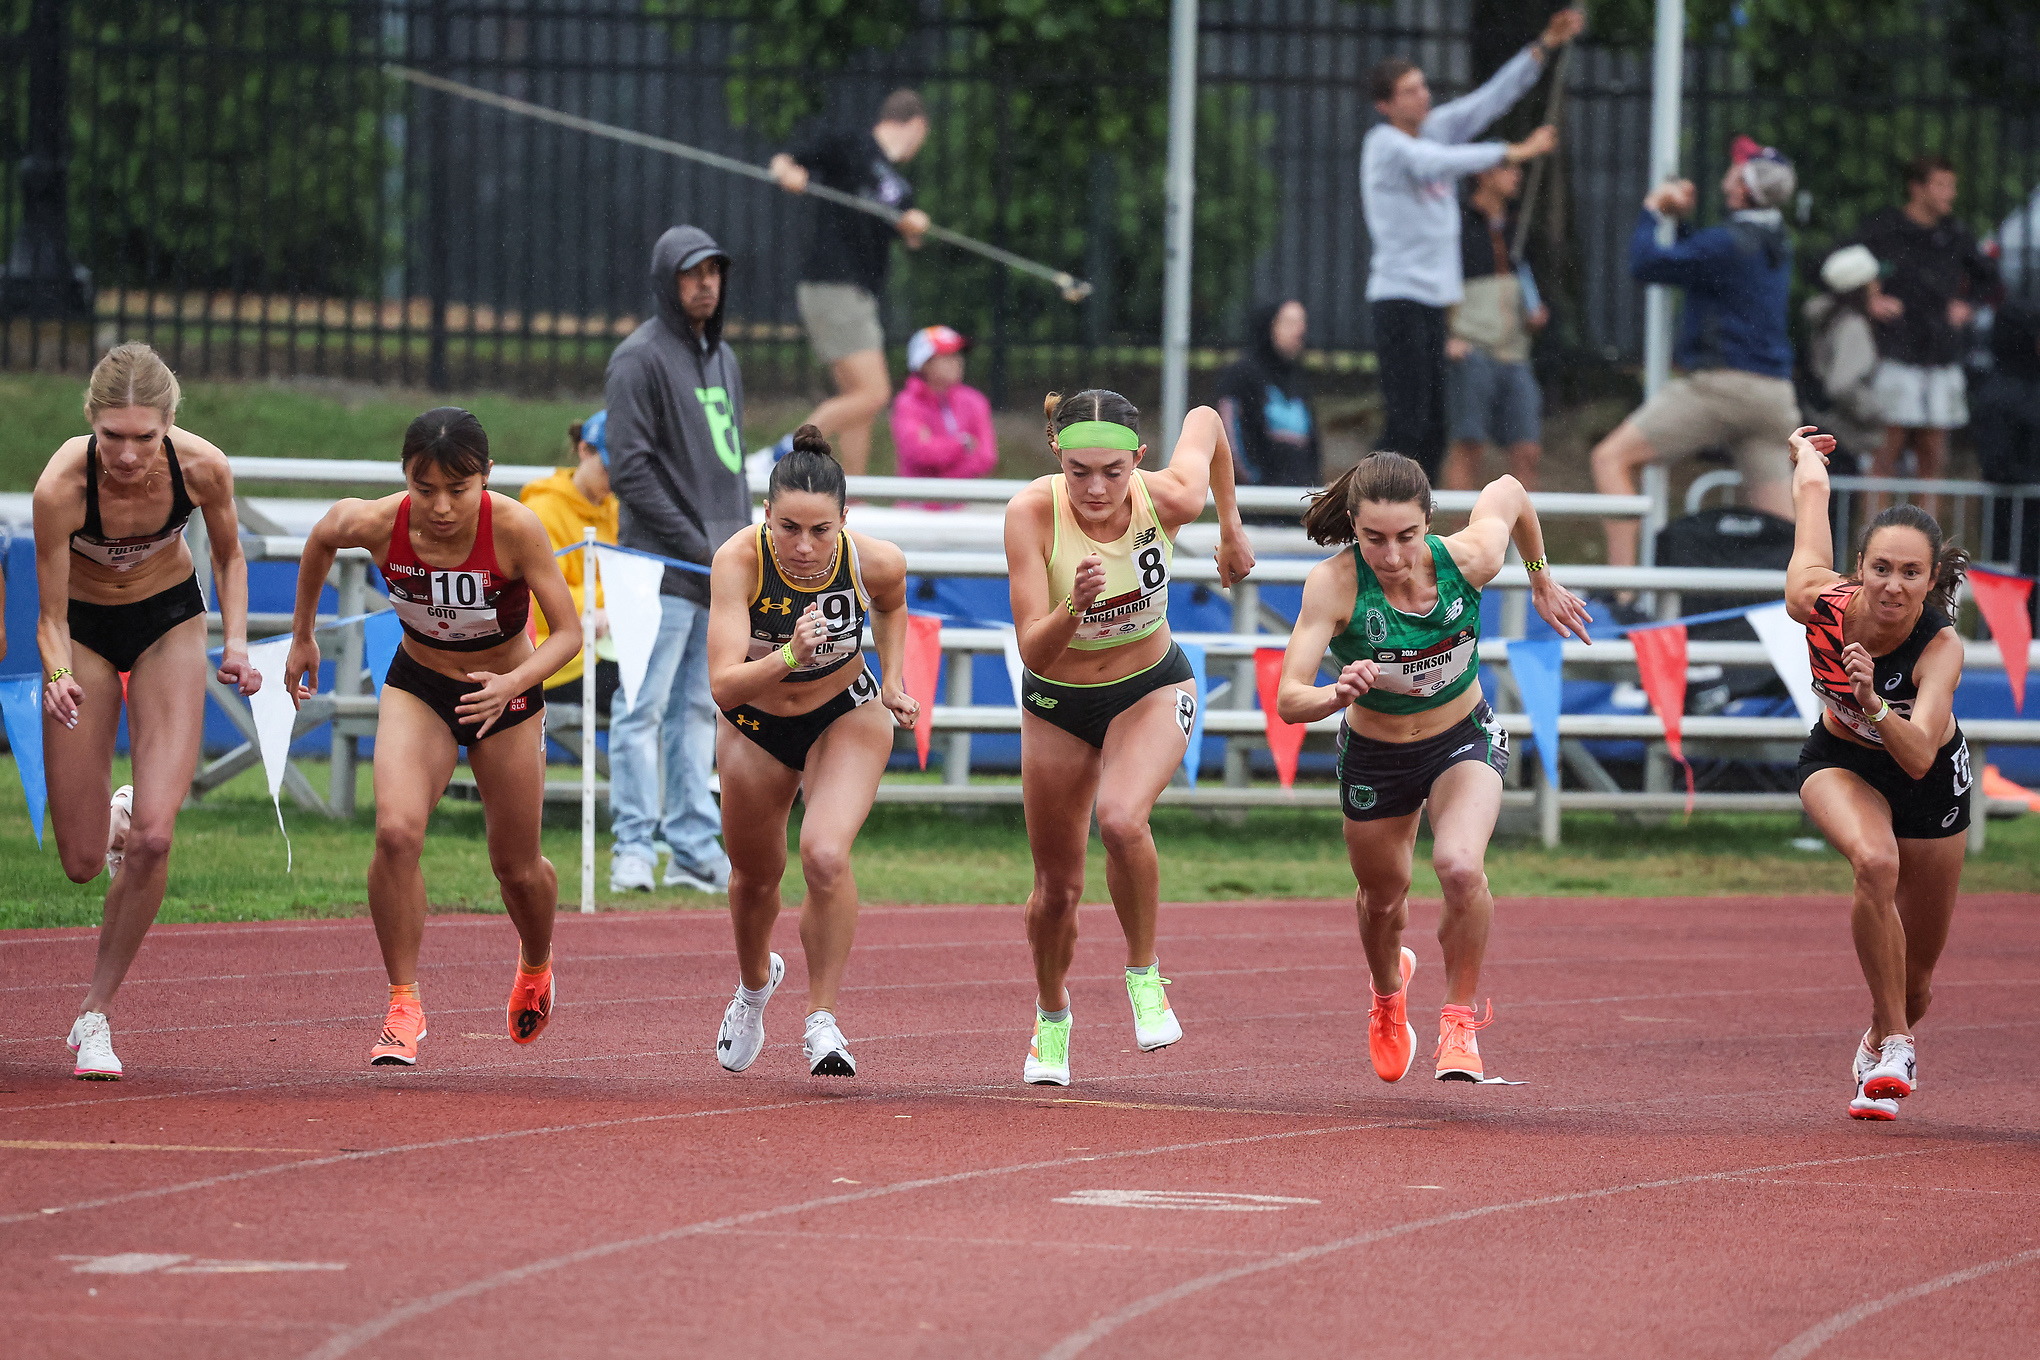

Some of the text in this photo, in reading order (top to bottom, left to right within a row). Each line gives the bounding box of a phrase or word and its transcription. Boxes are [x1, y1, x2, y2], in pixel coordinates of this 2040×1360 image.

[107, 543, 151, 555] FULTON
[389, 562, 426, 577] UNIQLO
[1138, 547, 1166, 589] 8
[435, 572, 477, 606] 10
[427, 606, 457, 620] GOTO
[823, 594, 851, 634] 9
[1401, 649, 1418, 657] 2024
[1403, 652, 1452, 675] BERKSON
[1835, 702, 1873, 726] VILJOE
